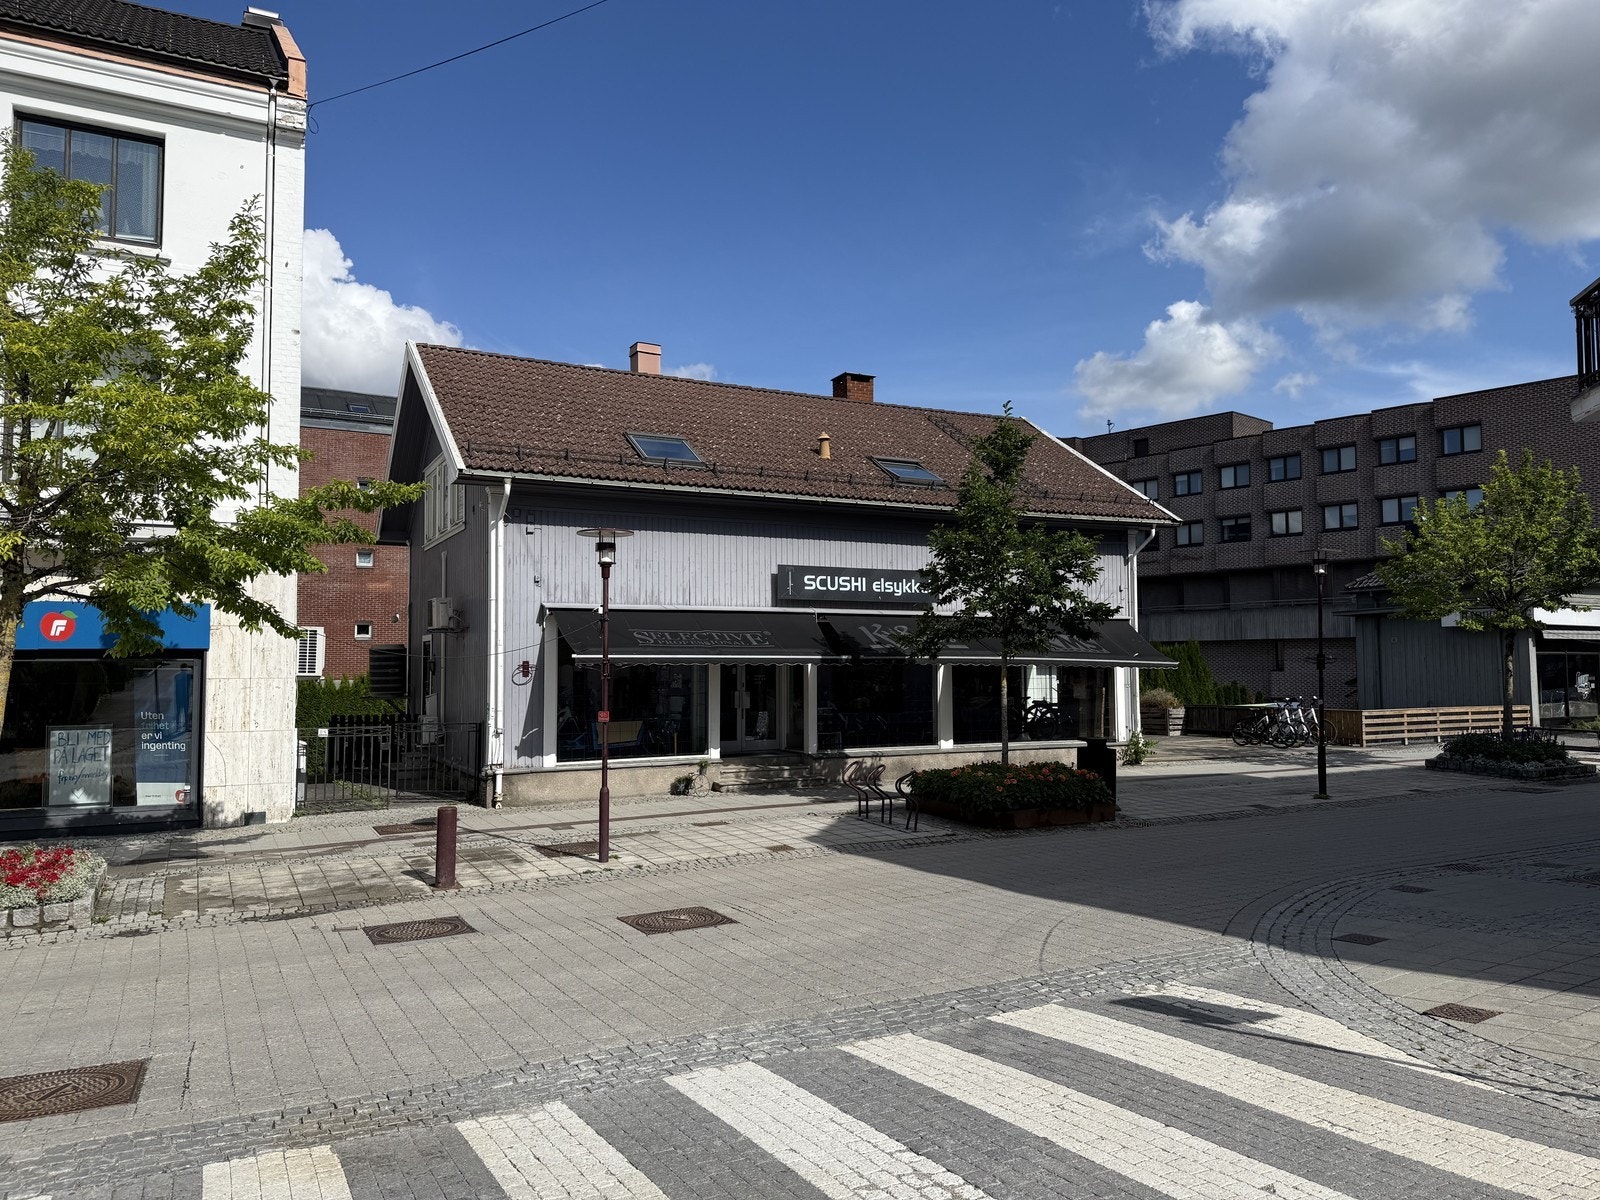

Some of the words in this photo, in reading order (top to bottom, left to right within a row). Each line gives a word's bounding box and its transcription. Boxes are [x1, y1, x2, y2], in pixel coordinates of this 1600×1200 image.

[803, 574, 867, 592] SCUSHI
[140, 711, 164, 720] Uten
[56, 731, 79, 747] BLI
[86, 731, 111, 745] MED
[141, 732, 153, 740] er
[154, 731, 163, 740] vi
[141, 741, 186, 752] ingenting
[53, 746, 68, 764] PÅ
[71, 746, 109, 763] LAGET
